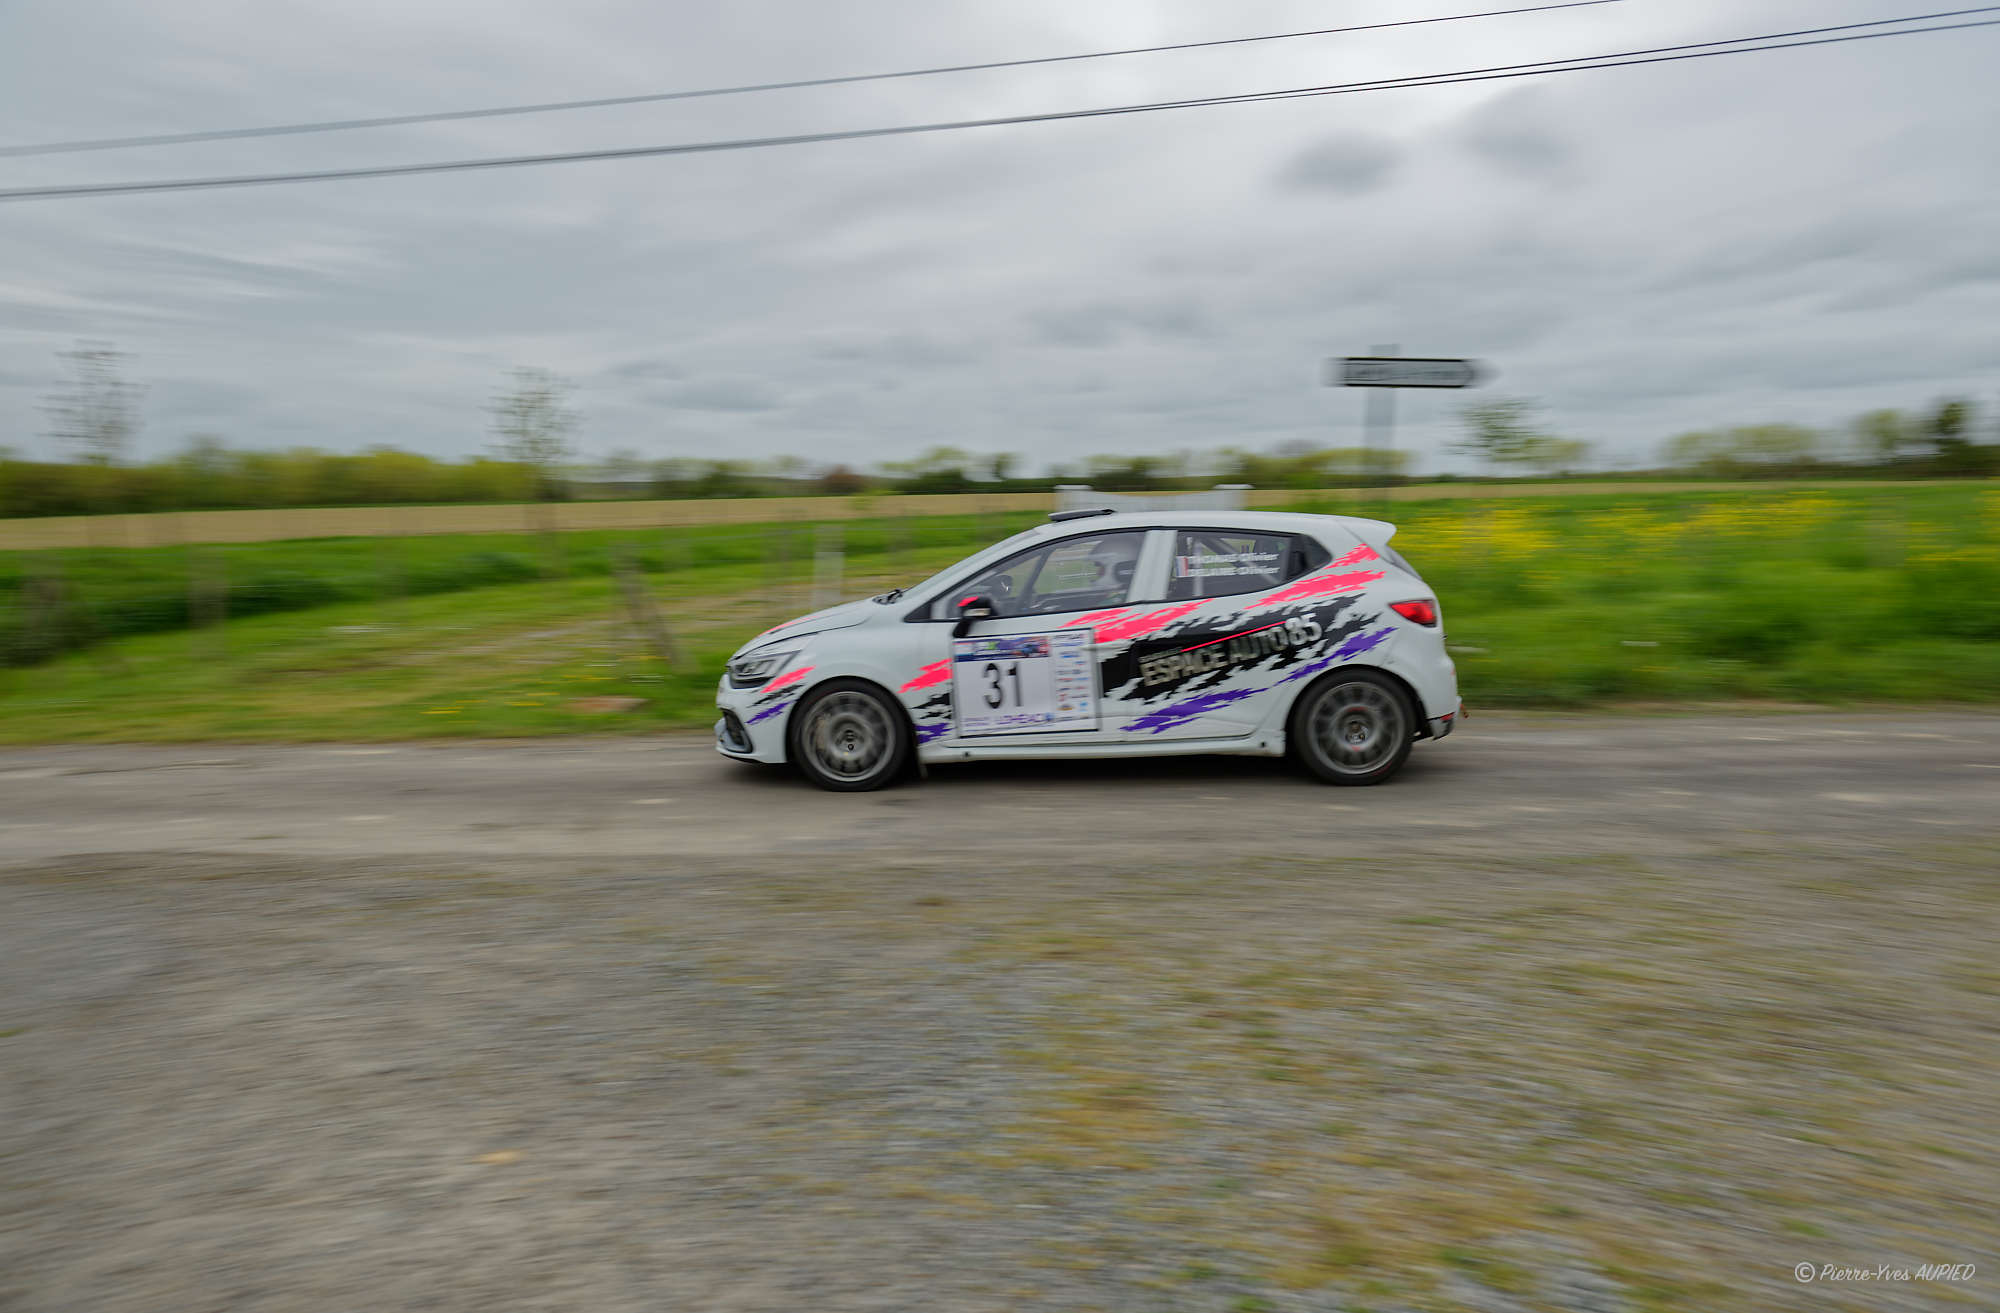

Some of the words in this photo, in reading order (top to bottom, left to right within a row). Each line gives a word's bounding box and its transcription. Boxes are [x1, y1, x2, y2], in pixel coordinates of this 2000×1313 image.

[1139, 645, 1229, 686] ESPACE
[1229, 626, 1288, 663] AUTO
[1285, 613, 1322, 646] 85
[983, 662, 1022, 709] 31
